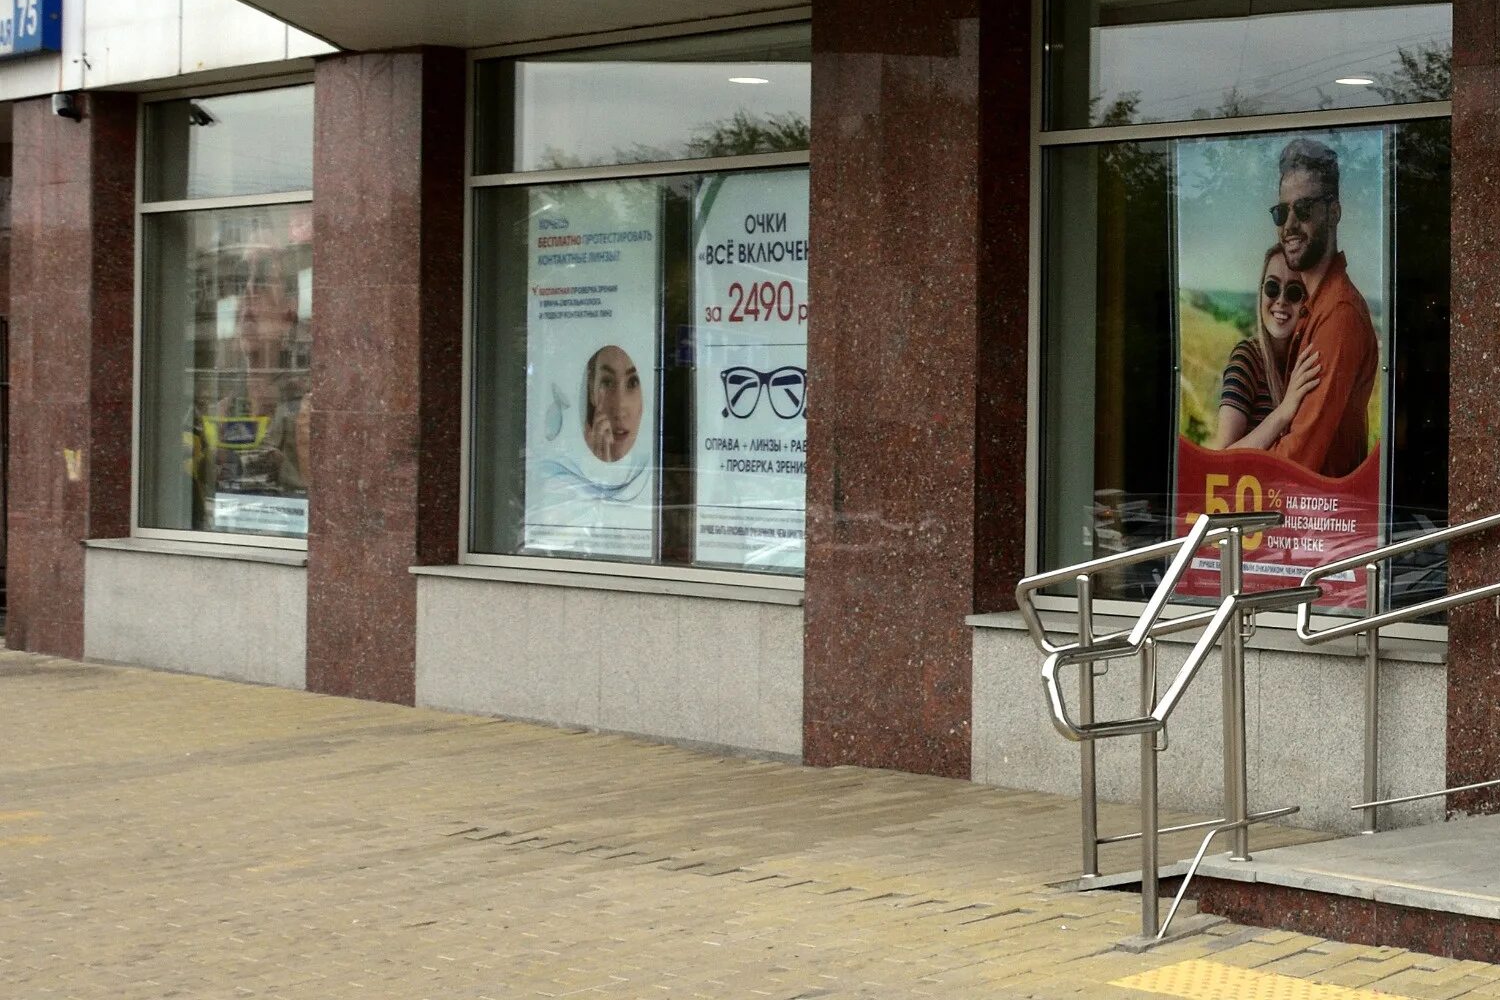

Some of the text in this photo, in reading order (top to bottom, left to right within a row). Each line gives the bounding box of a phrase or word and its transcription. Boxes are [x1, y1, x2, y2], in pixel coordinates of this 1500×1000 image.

[745, 212, 787, 234] ОЧКИ
[706, 306, 722, 322] за
[729, 280, 794, 322] 2490
[705, 438, 739, 451] ОПРАВА
[750, 440, 782, 452] ЛИНЗЫ
[727, 460, 774, 473] ПРОВЕРКА
[1286, 497, 1299, 509] НА
[1300, 496, 1338, 512] ВТОРЫЕ
[1277, 516, 1357, 533] НЦЕЗАЩИТНЫЕ
[1267, 535, 1324, 552] ОЧКИ В ЧЕКЕ
